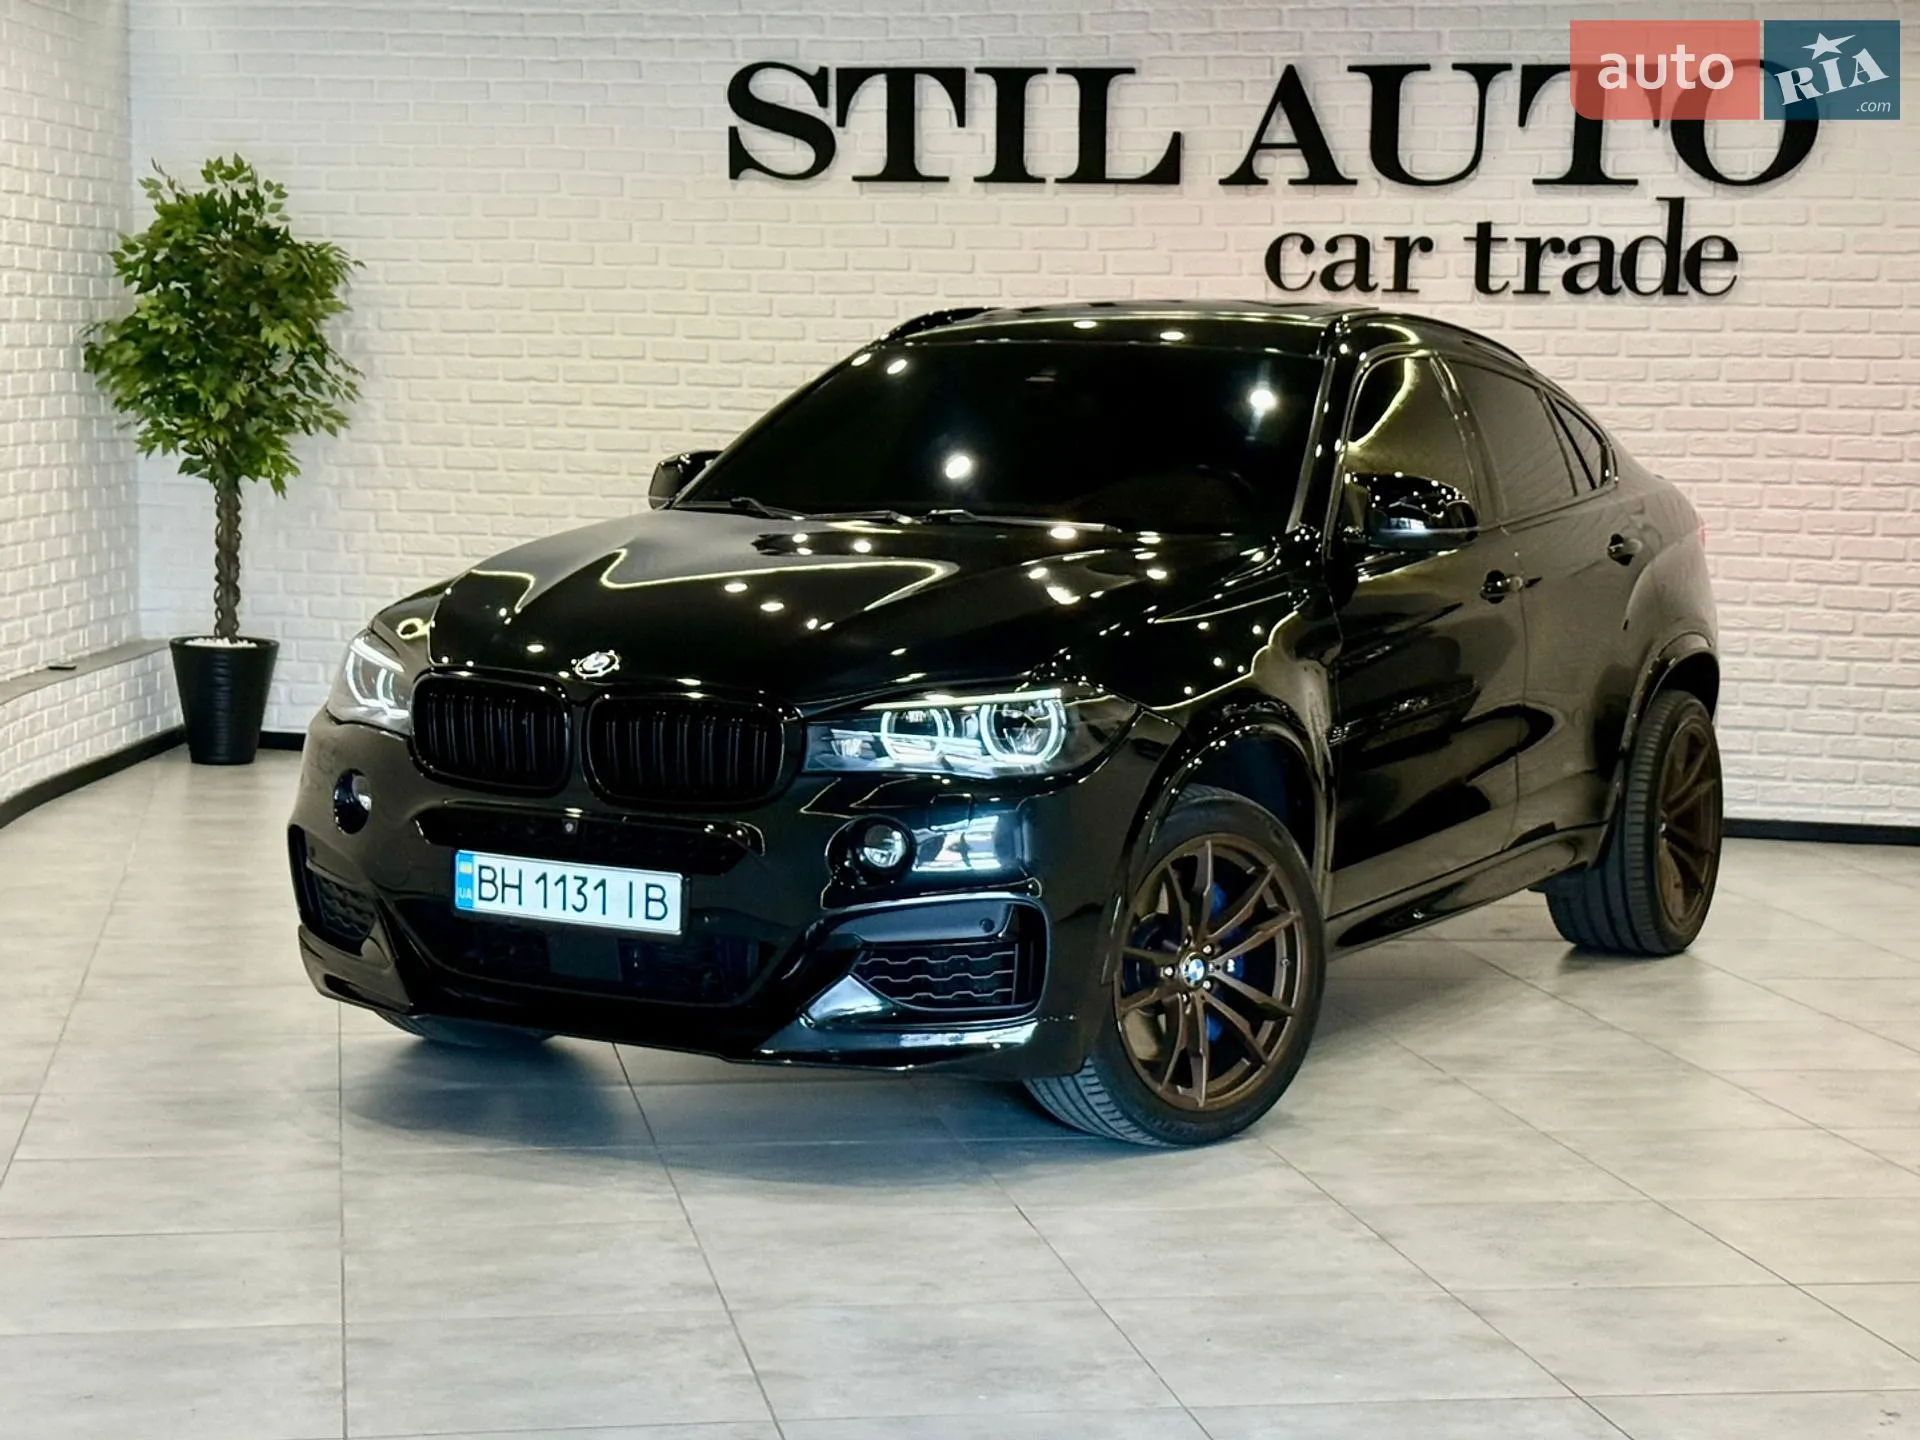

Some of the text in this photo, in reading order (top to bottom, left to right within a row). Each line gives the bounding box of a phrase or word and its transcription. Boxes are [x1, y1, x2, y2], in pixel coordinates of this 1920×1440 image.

[728, 59, 1820, 187] STIL AUTO
[1266, 196, 1739, 297] car trade
[478, 864, 523, 906] BH
[535, 872, 607, 916] 1131
